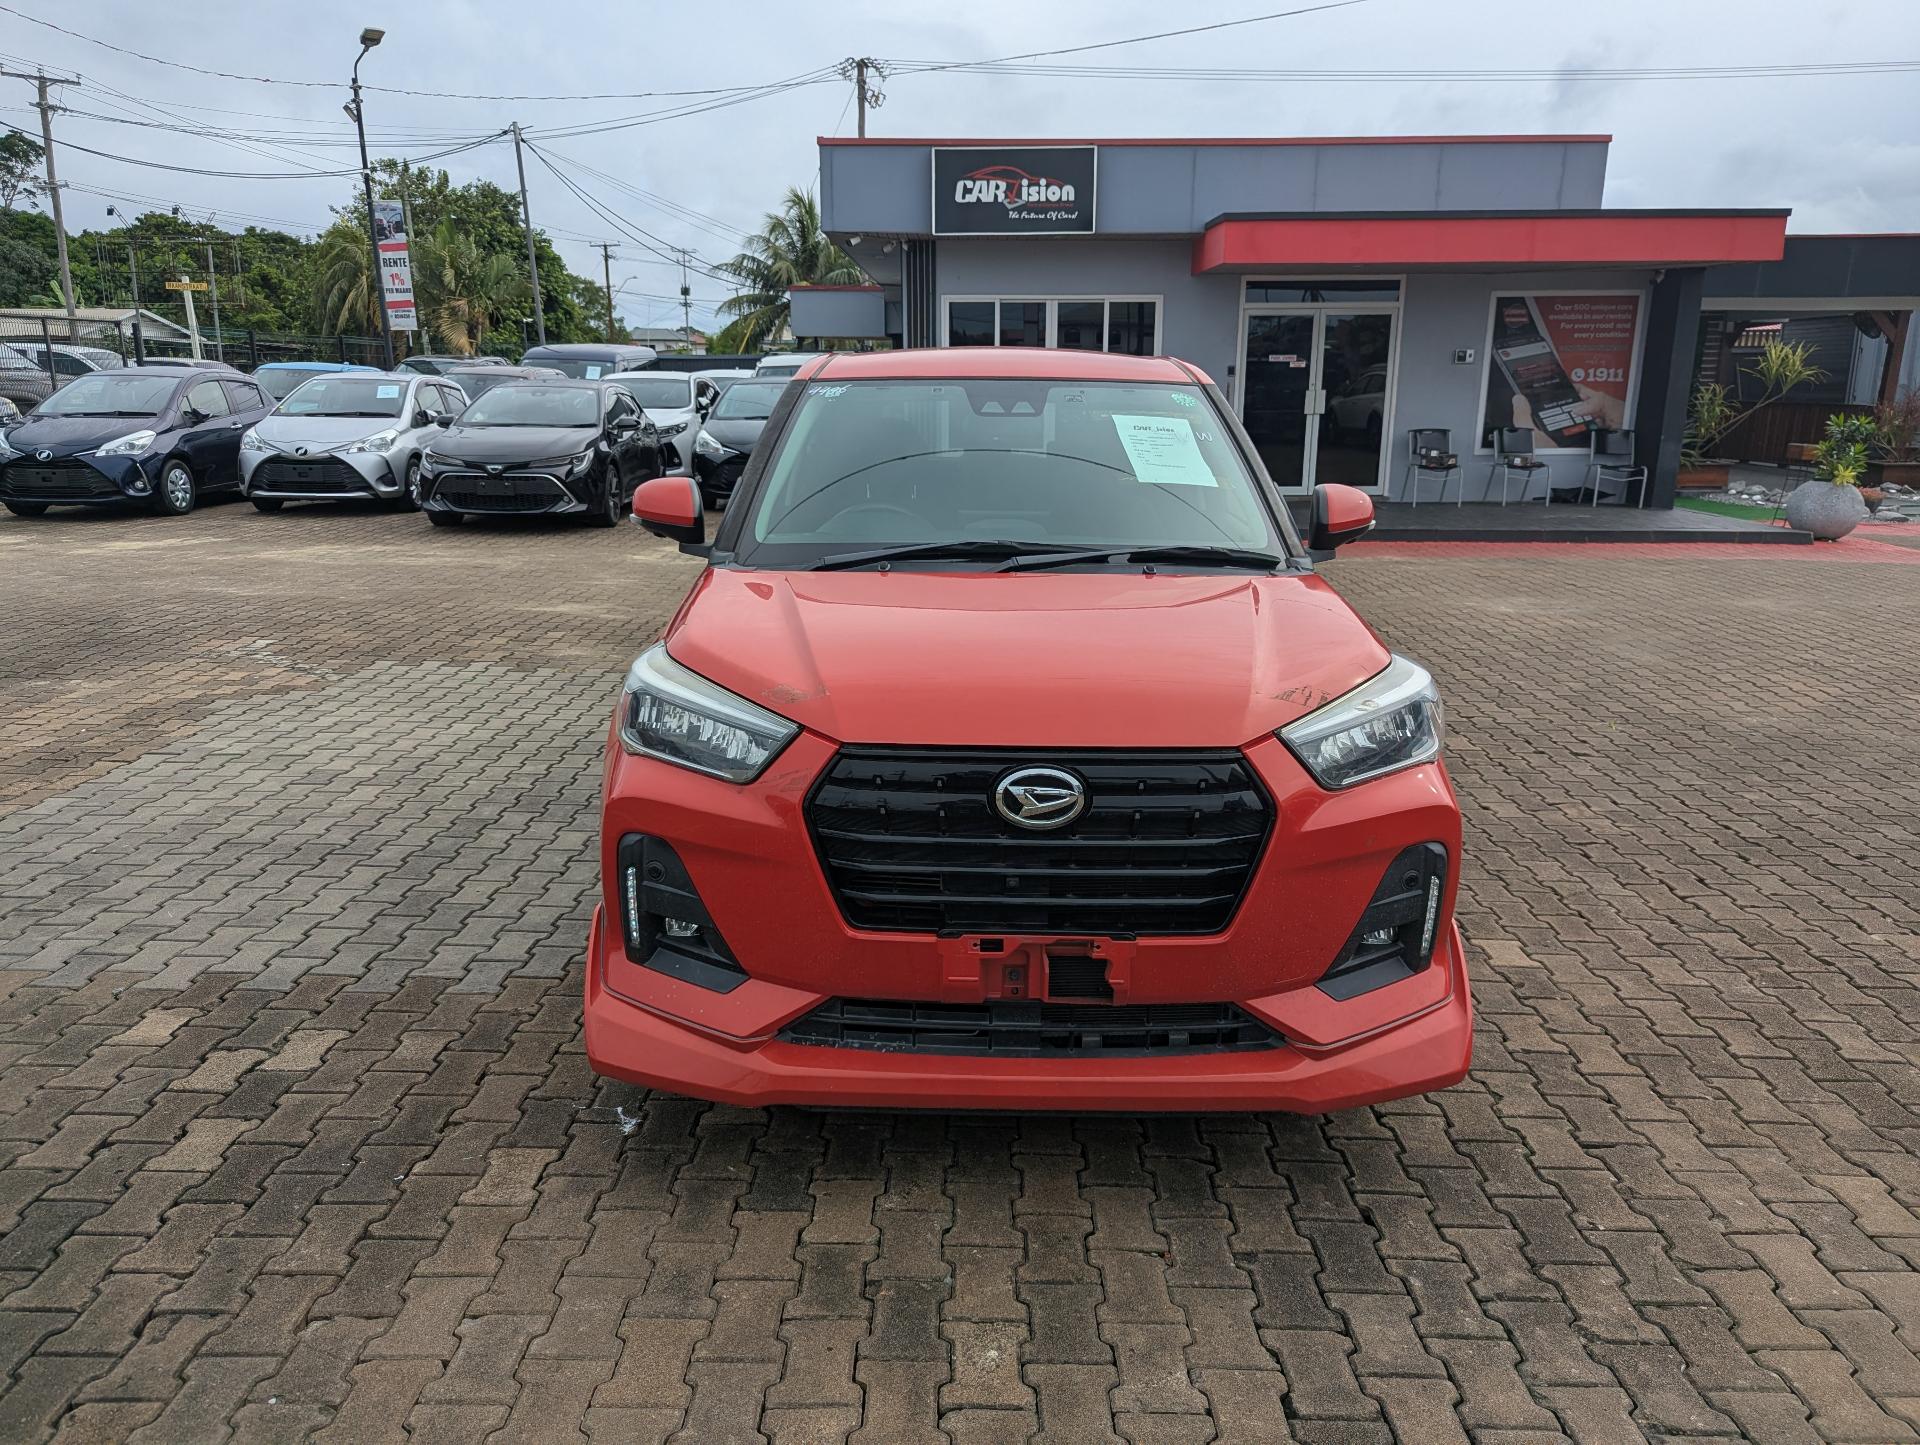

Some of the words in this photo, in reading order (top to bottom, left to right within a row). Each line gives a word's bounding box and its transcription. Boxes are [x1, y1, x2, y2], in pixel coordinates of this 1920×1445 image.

[1008, 210, 1020, 219] The
[1020, 210, 1046, 219] Future
[1046, 211, 1058, 221] Of
[382, 257, 408, 268] RENTE
[389, 272, 405, 286] 1%
[1573, 303, 1590, 311] 500
[1590, 304, 1616, 313] unique
[1548, 313, 1583, 321] available
[1605, 312, 1632, 320] rentals
[1574, 323, 1596, 331] every
[1587, 368, 1624, 382] 1911
